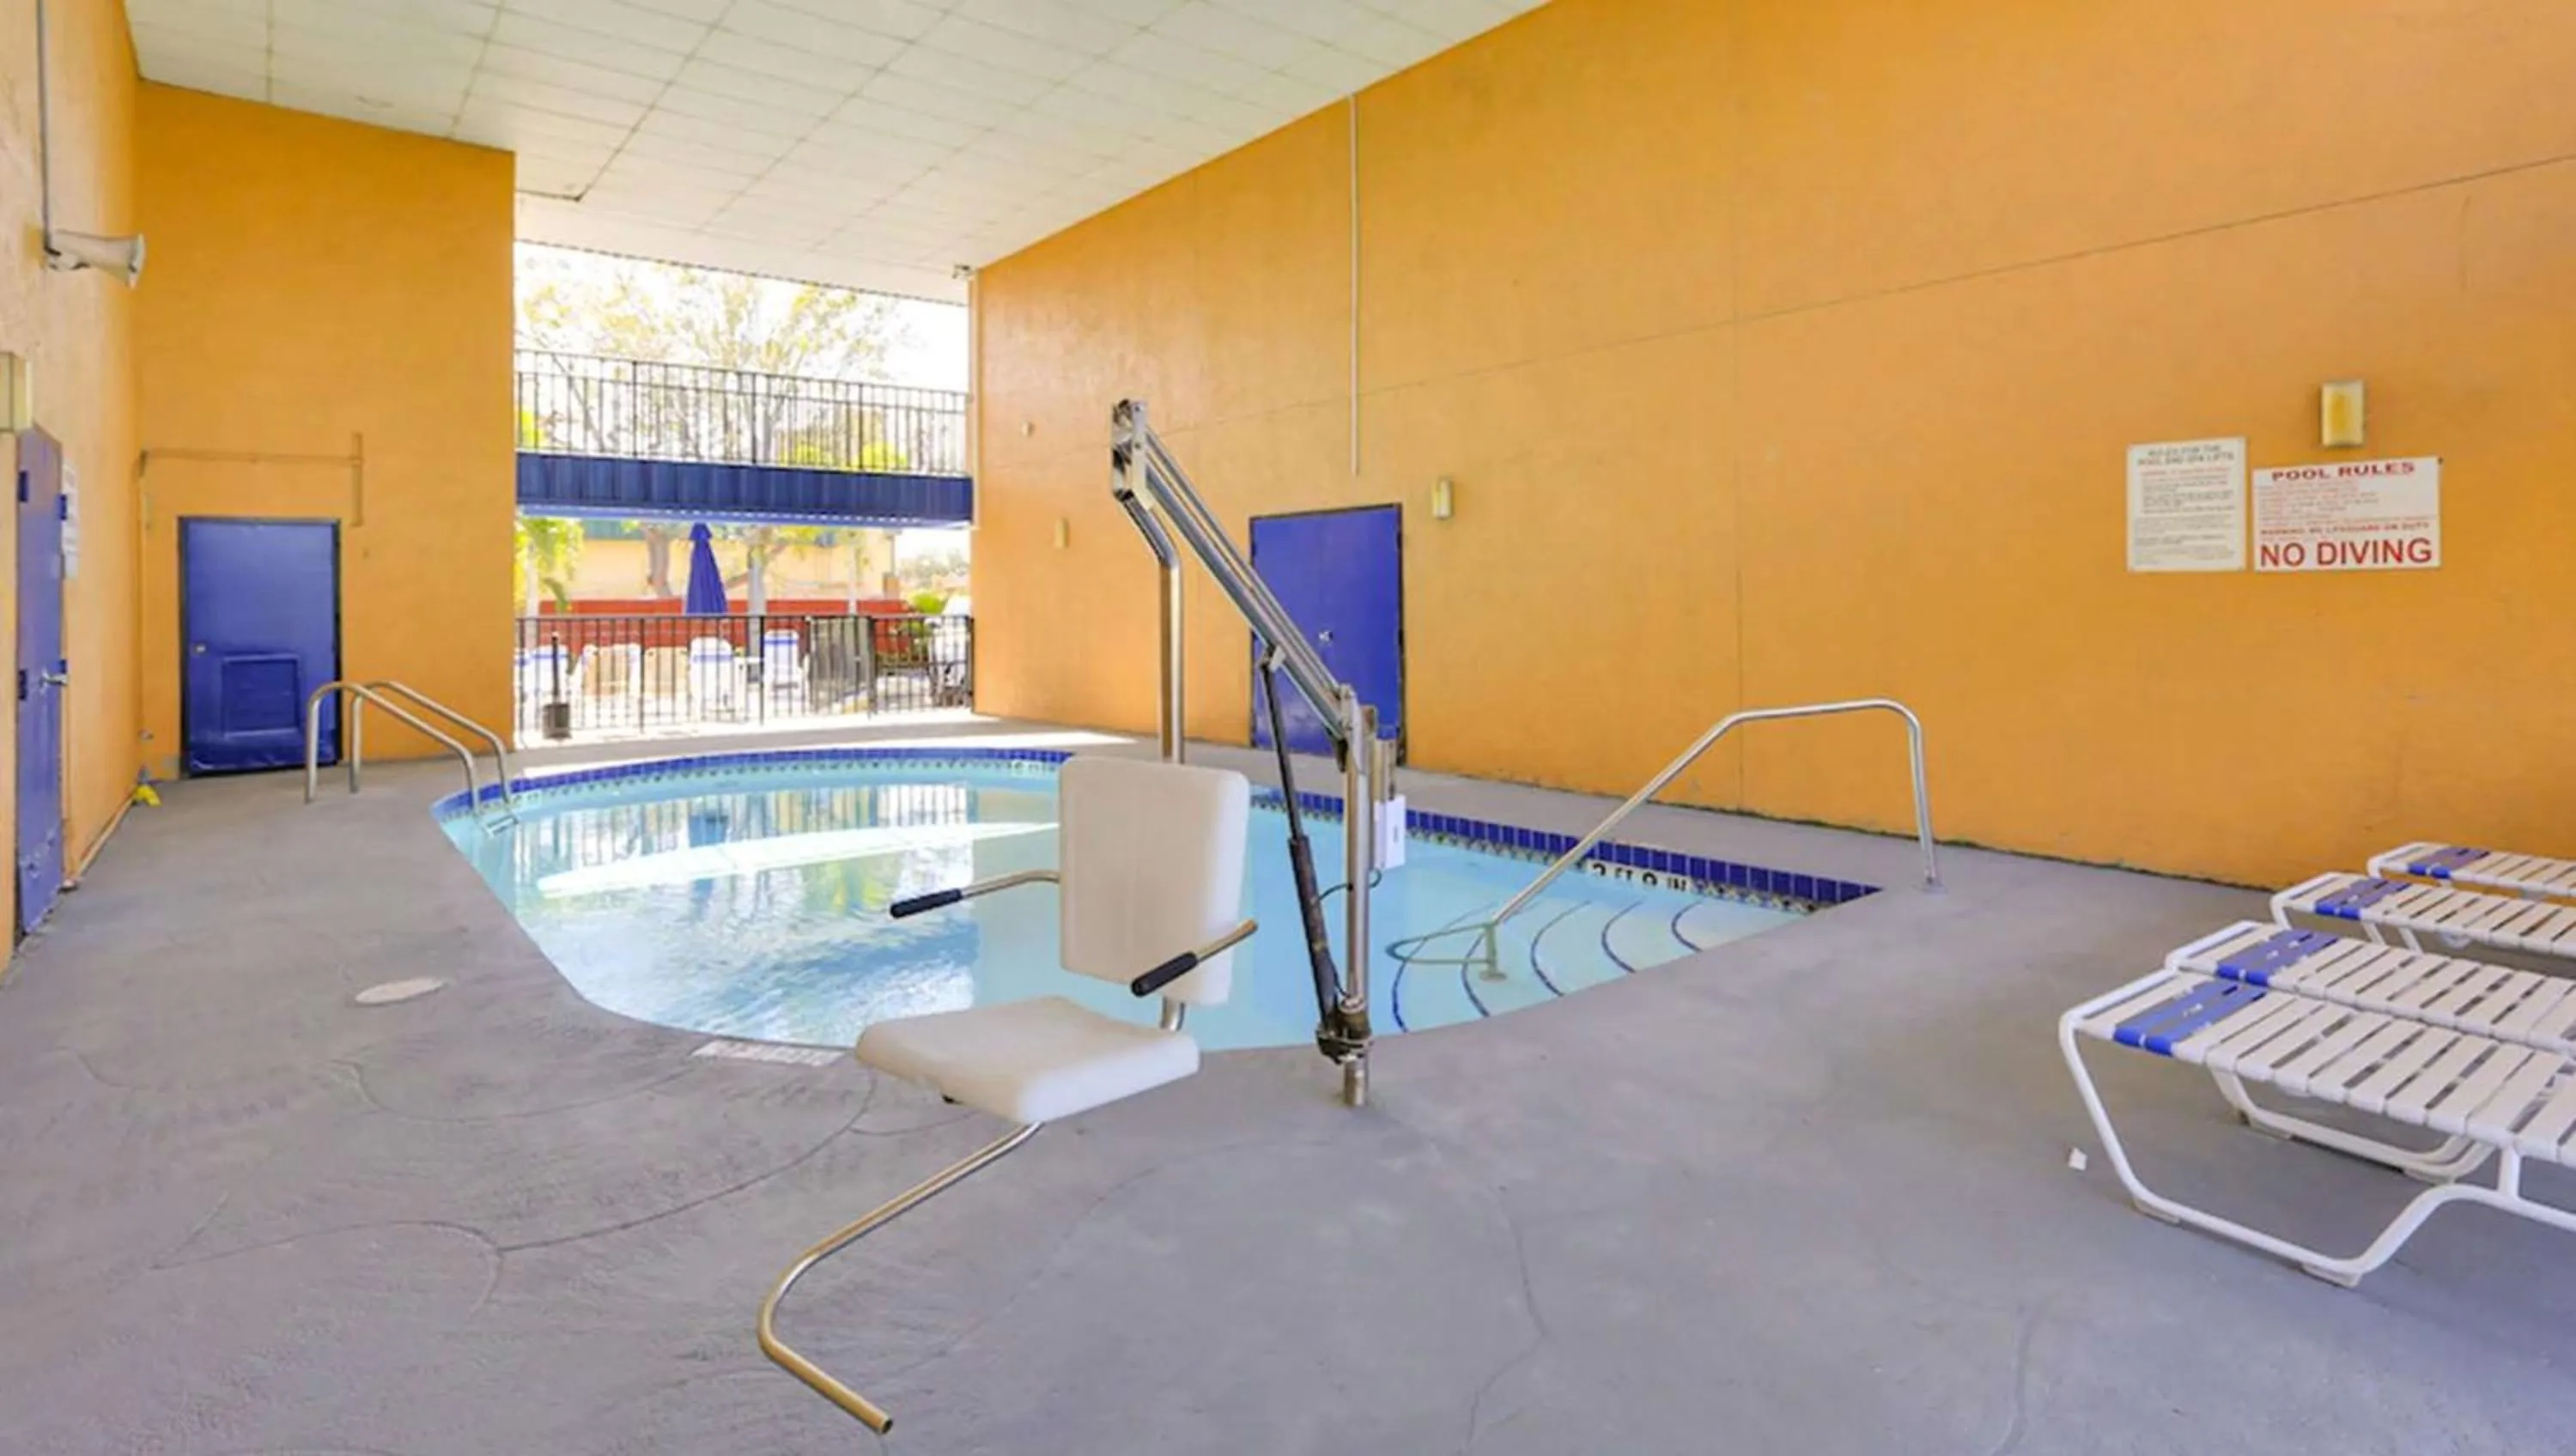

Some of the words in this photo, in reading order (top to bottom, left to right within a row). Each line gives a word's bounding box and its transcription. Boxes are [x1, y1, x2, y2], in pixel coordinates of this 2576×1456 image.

[2271, 468, 2330, 481] POOL
[2338, 462, 2415, 477] RULES
[2260, 542, 2305, 567] NO
[2317, 537, 2432, 566] DIVING
